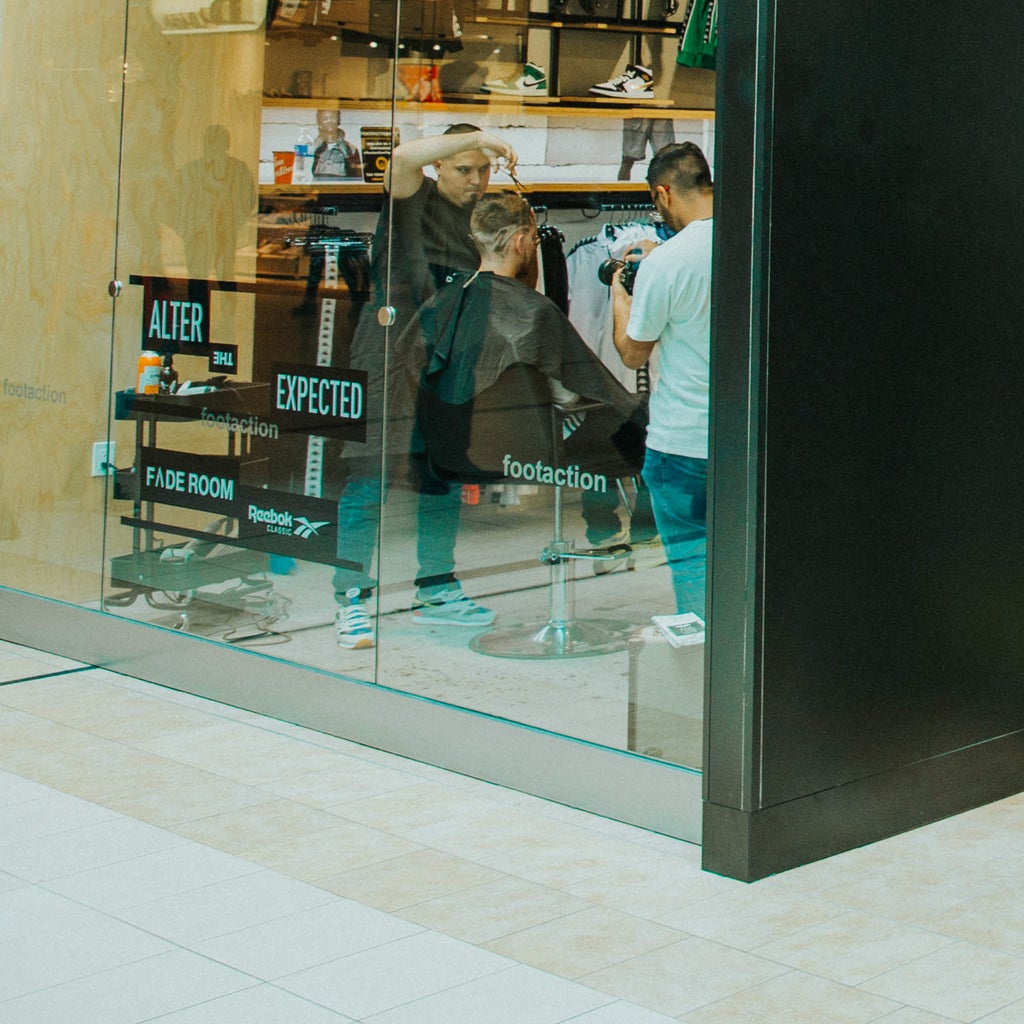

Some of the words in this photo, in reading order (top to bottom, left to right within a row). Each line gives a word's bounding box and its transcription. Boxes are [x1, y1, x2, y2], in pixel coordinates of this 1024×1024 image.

[149, 299, 203, 343] ALTER
[213, 351, 234, 366] THE
[3, 378, 67, 405] footaction
[276, 374, 363, 420] EXPECTED
[200, 407, 280, 440] footaction
[146, 466, 185, 492] FADE
[188, 473, 234, 501] ROOM
[503, 454, 607, 493] footaction
[248, 504, 293, 527] Reebok
[266, 524, 293, 536] CLASSIC
